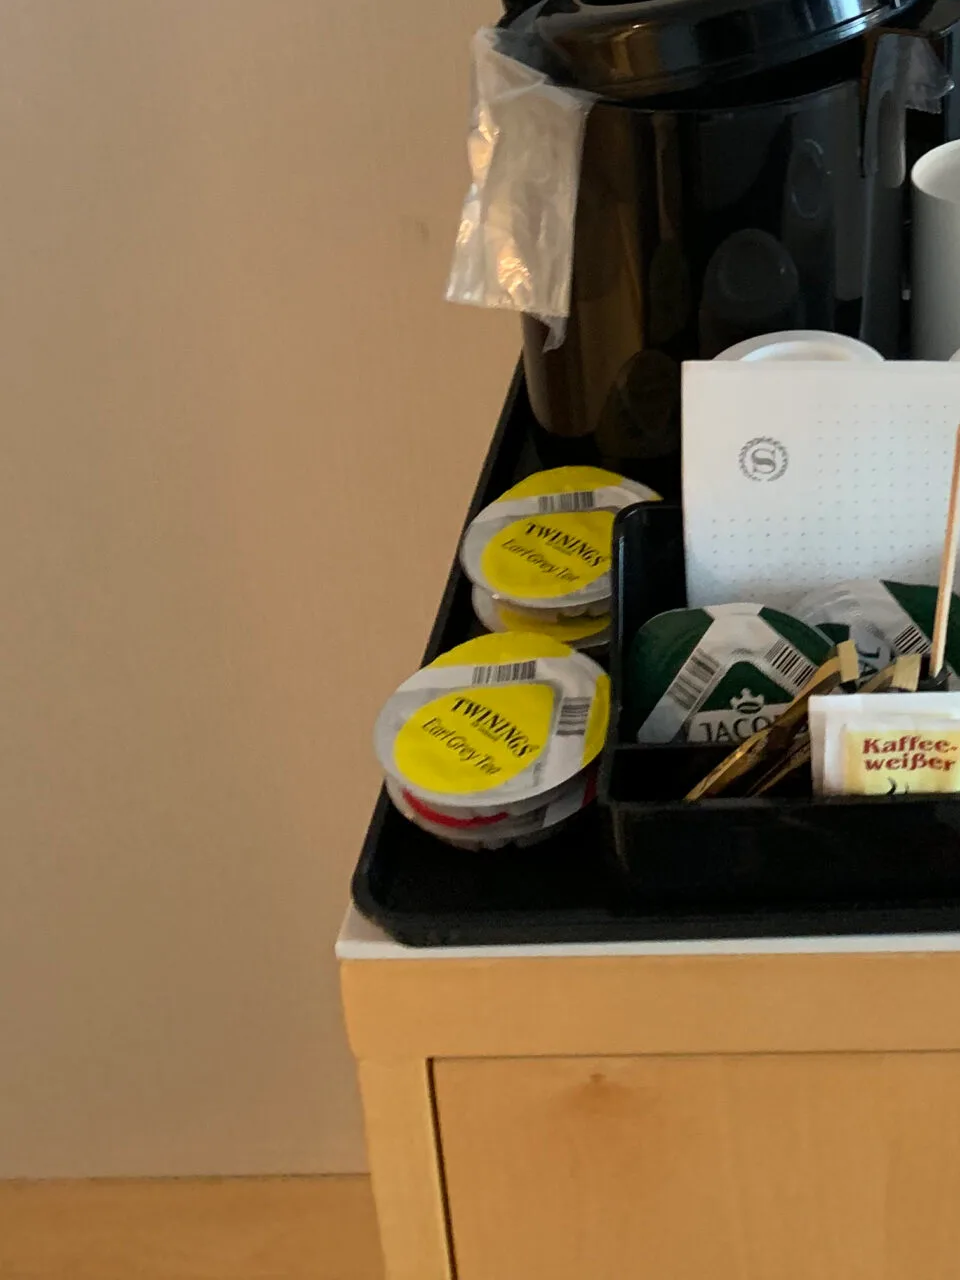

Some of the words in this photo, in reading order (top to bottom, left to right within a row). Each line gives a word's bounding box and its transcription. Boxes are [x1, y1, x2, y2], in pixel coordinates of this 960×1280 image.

[525, 521, 609, 568] TWININGS
[421, 716, 458, 742] Earl
[446, 735, 482, 762] Grey
[451, 696, 540, 758] TWININGS
[698, 714, 782, 742] JACO
[864, 753, 957, 772] weißer
